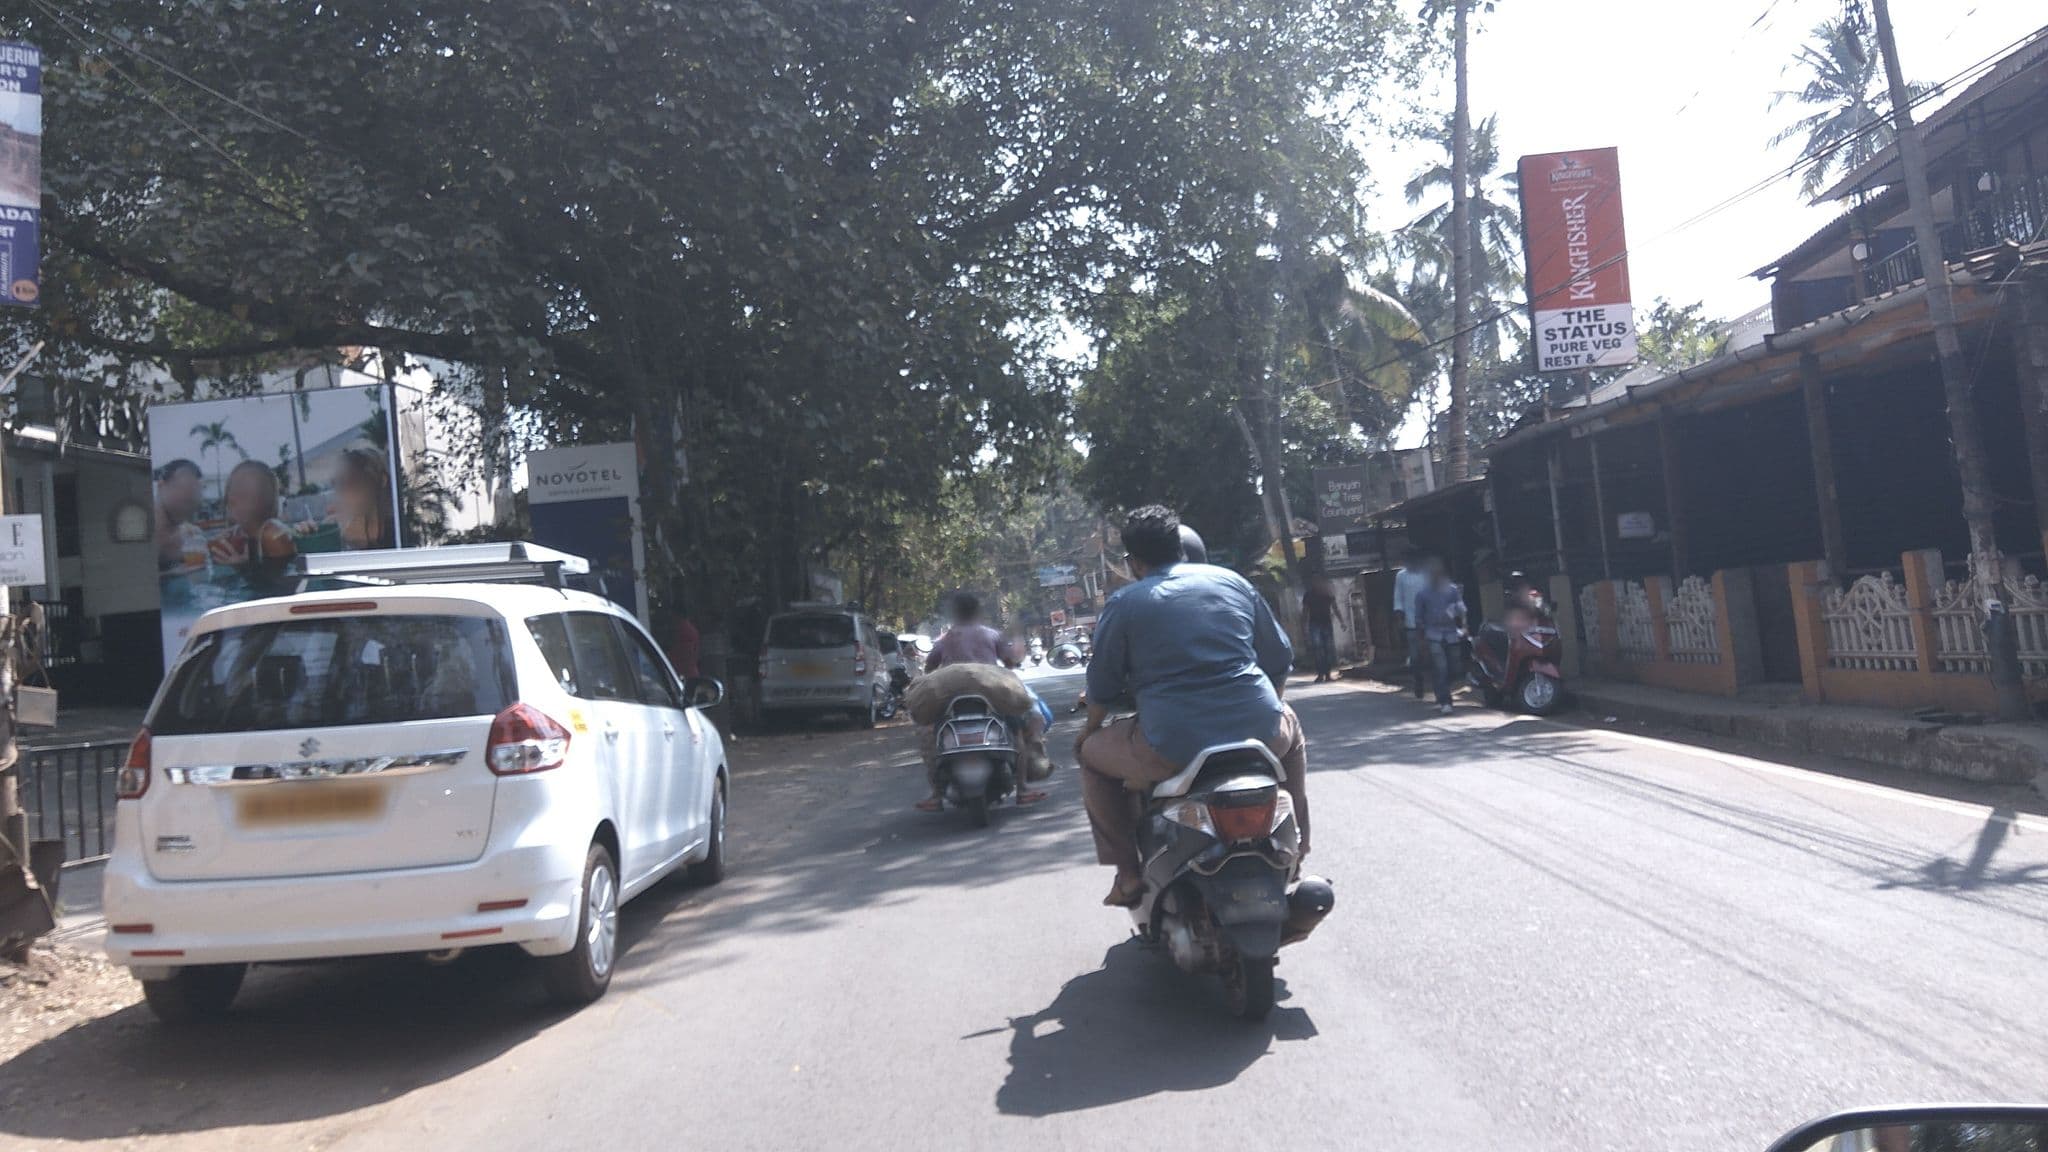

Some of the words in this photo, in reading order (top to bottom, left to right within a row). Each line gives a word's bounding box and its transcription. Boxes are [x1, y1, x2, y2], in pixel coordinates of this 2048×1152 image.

[1562, 191, 1596, 301] KINGFISHER
[1562, 308, 1607, 325] THE
[1544, 322, 1627, 341] STATUS
[1550, 341, 1589, 355] PURE
[1592, 337, 1623, 350] VEG
[1544, 353, 1582, 368] REST
[1585, 352, 1597, 365] &
[536, 469, 623, 487] NOVOTEL
